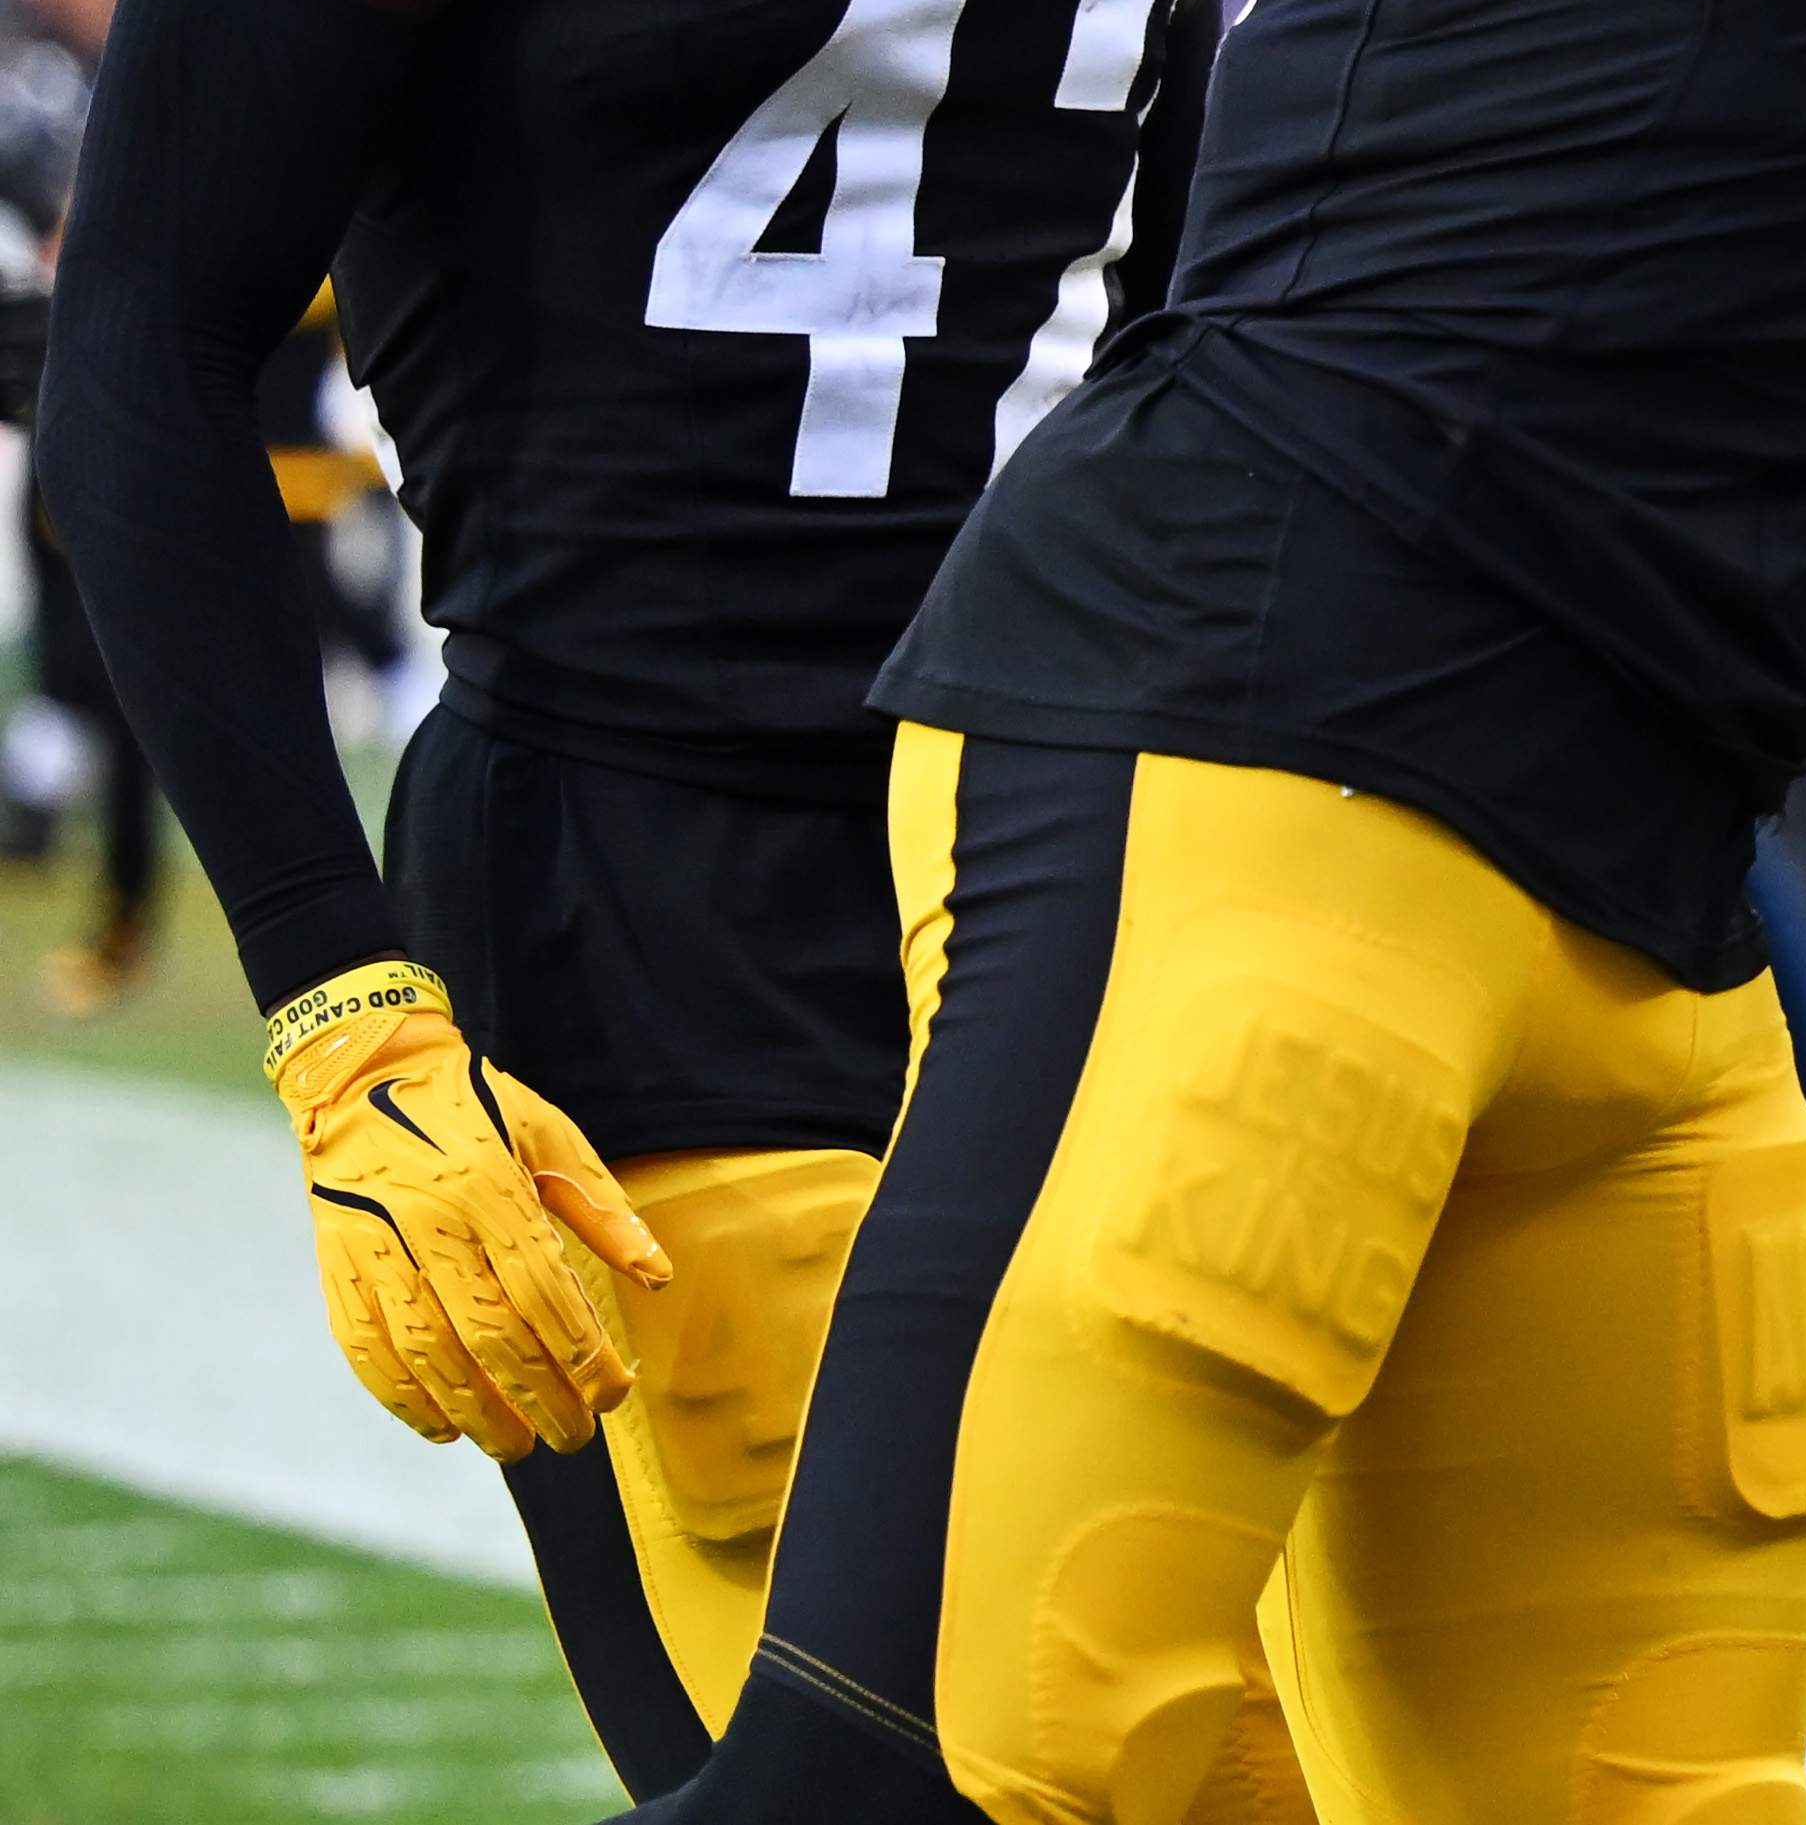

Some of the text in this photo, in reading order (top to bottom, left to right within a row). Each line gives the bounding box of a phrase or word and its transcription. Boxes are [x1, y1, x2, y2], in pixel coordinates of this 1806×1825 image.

[265, 985, 417, 1071] GOD CAN'T FAIL
[286, 989, 328, 1024] GOD
[1178, 1015, 1468, 1216] JESUS
[1118, 1152, 1406, 1350] KING
